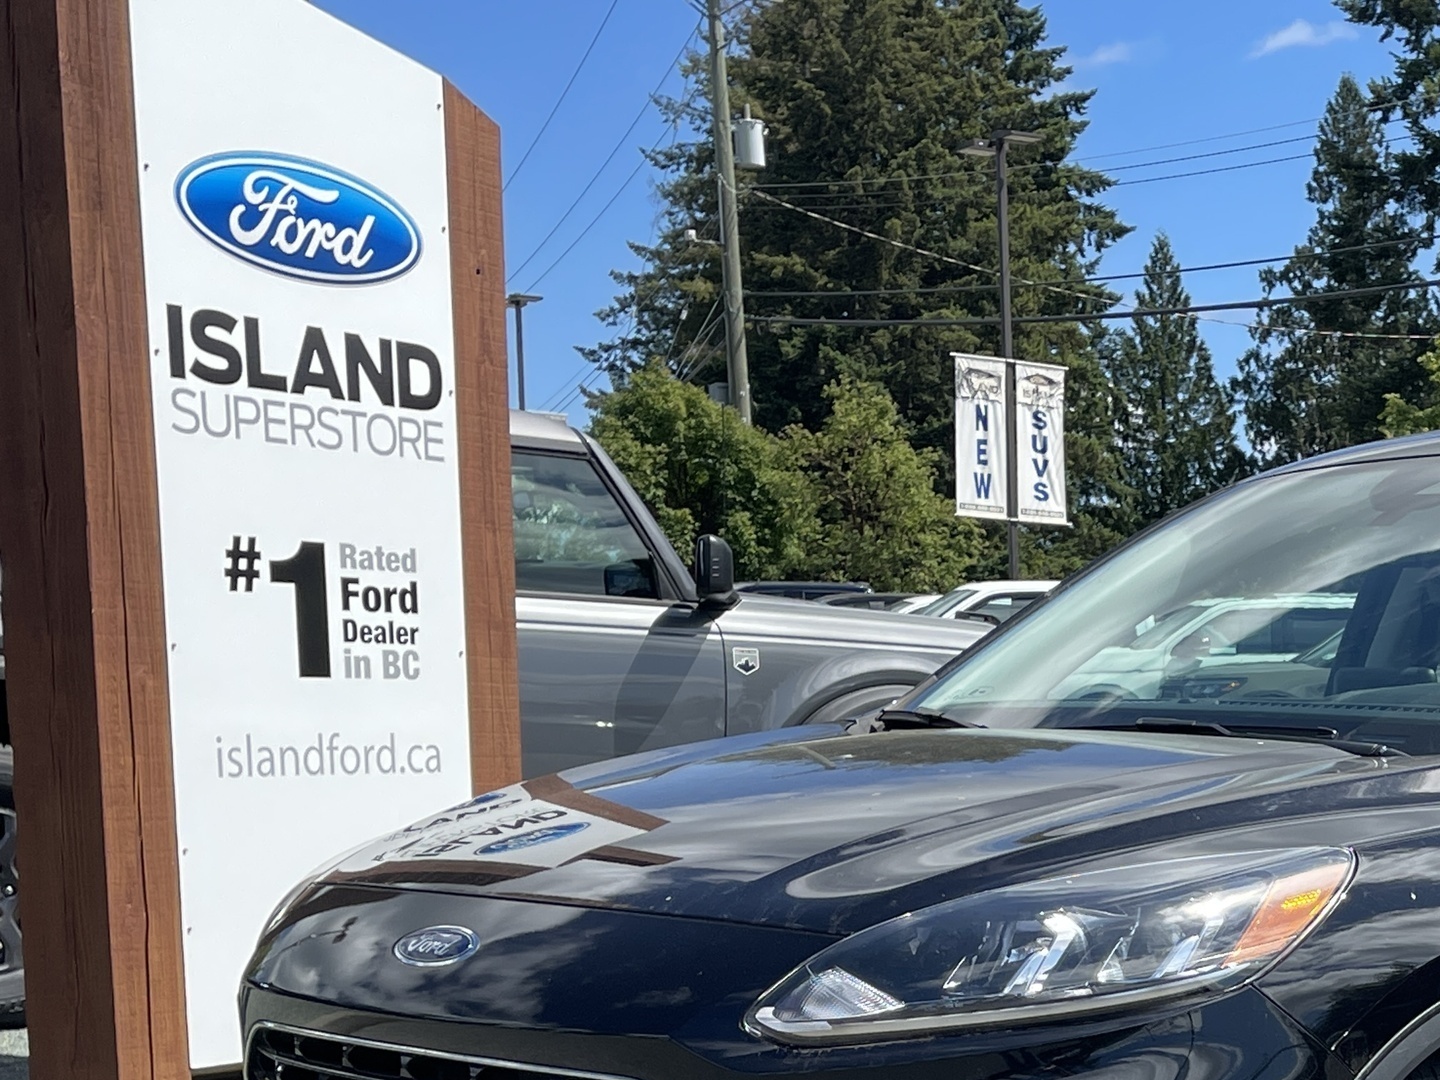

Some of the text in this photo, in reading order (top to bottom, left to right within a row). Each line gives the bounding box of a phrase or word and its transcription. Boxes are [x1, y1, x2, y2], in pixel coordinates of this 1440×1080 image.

[229, 169, 375, 268] Ford
[166, 303, 442, 411] ISLAND
[171, 387, 445, 462] SUPERSTORE
[973, 404, 991, 499] NEW
[1031, 410, 1049, 501] SUVS
[339, 542, 417, 574] Rated
[224, 535, 331, 678] #1
[340, 576, 418, 614] Ford
[342, 618, 419, 645] Dealer
[344, 648, 420, 680] in BC
[216, 732, 442, 778] islandford.ca
[407, 933, 464, 956] Ford
